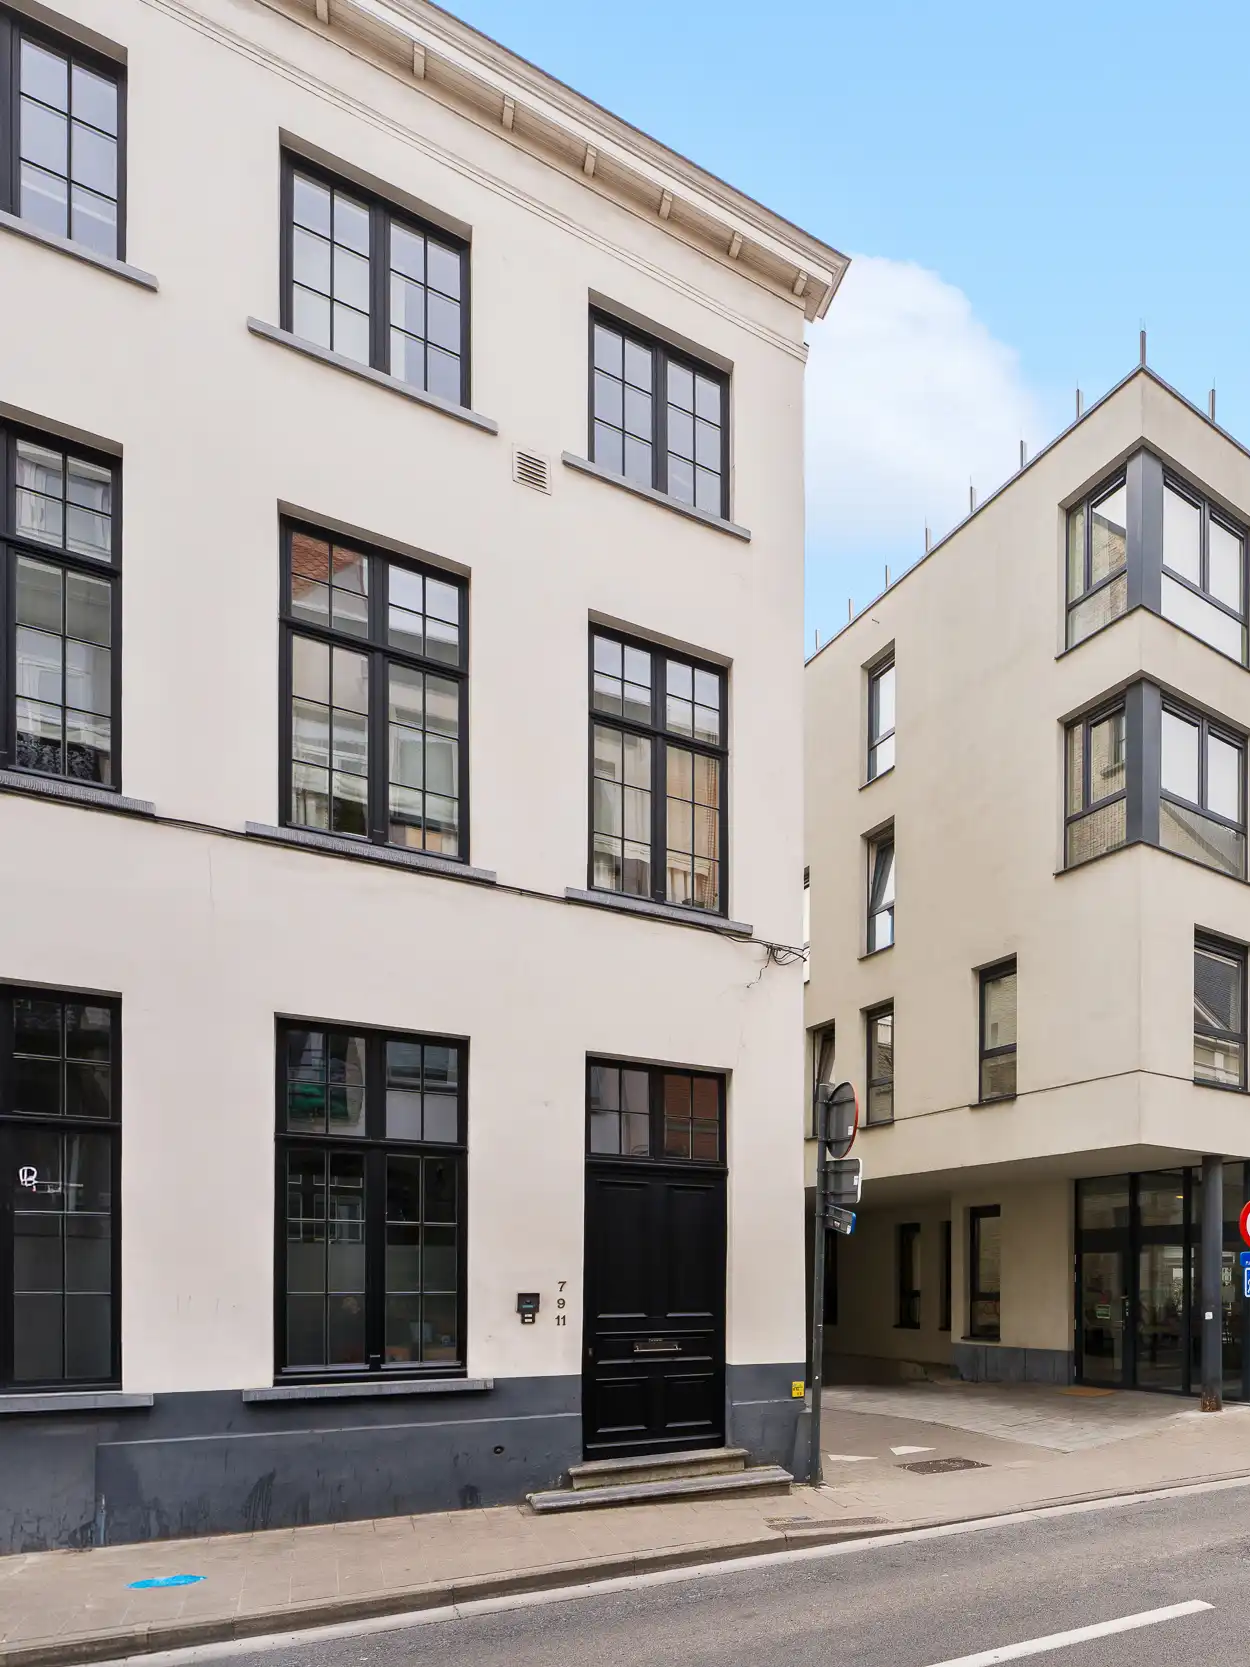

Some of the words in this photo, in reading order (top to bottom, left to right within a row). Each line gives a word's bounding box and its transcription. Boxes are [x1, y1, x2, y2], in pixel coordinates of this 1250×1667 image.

[557, 1280, 567, 1292] 7
[556, 1298, 566, 1309] 9
[555, 1315, 567, 1326] 11
